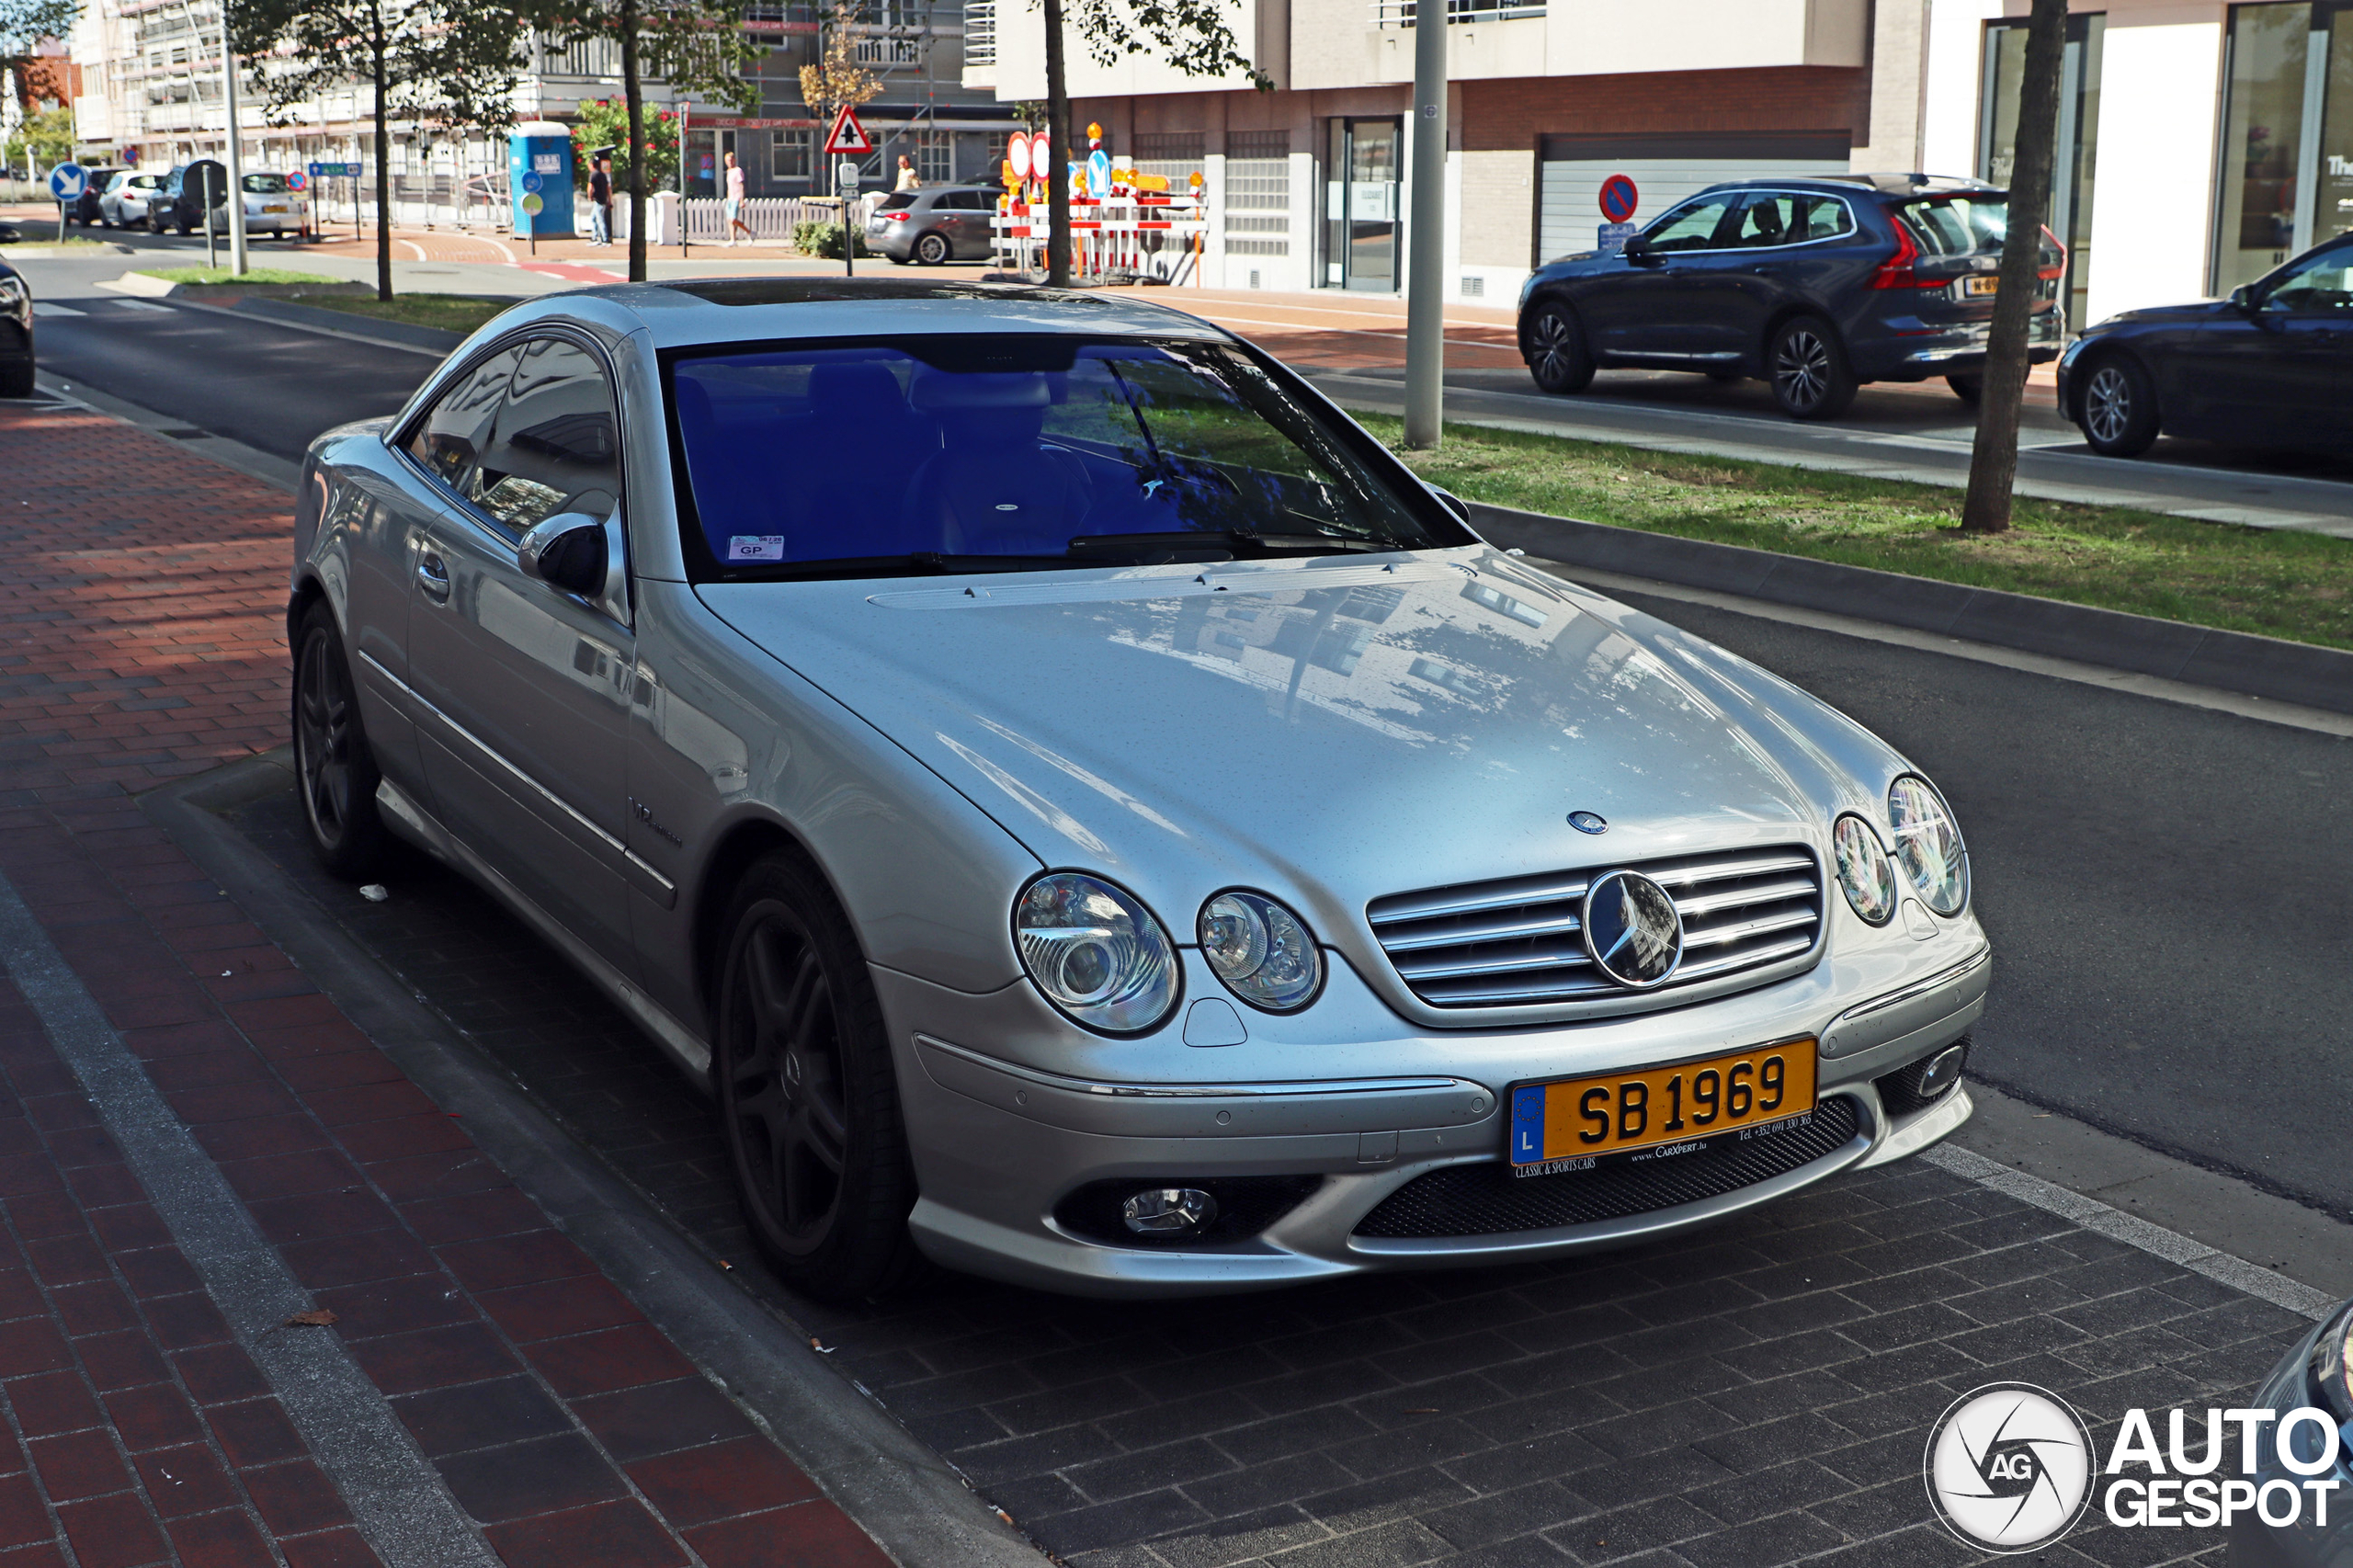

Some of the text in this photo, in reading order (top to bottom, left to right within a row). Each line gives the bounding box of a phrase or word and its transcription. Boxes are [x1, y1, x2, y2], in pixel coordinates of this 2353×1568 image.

[740, 546, 762, 554] GP
[1578, 1054, 1785, 1144] SB 1969
[1739, 1114, 1812, 1141] Tel. +352 691 330 365
[1522, 1131, 1533, 1151] L
[1516, 1156, 1596, 1178] CLASSIC & SPORTS CARS
